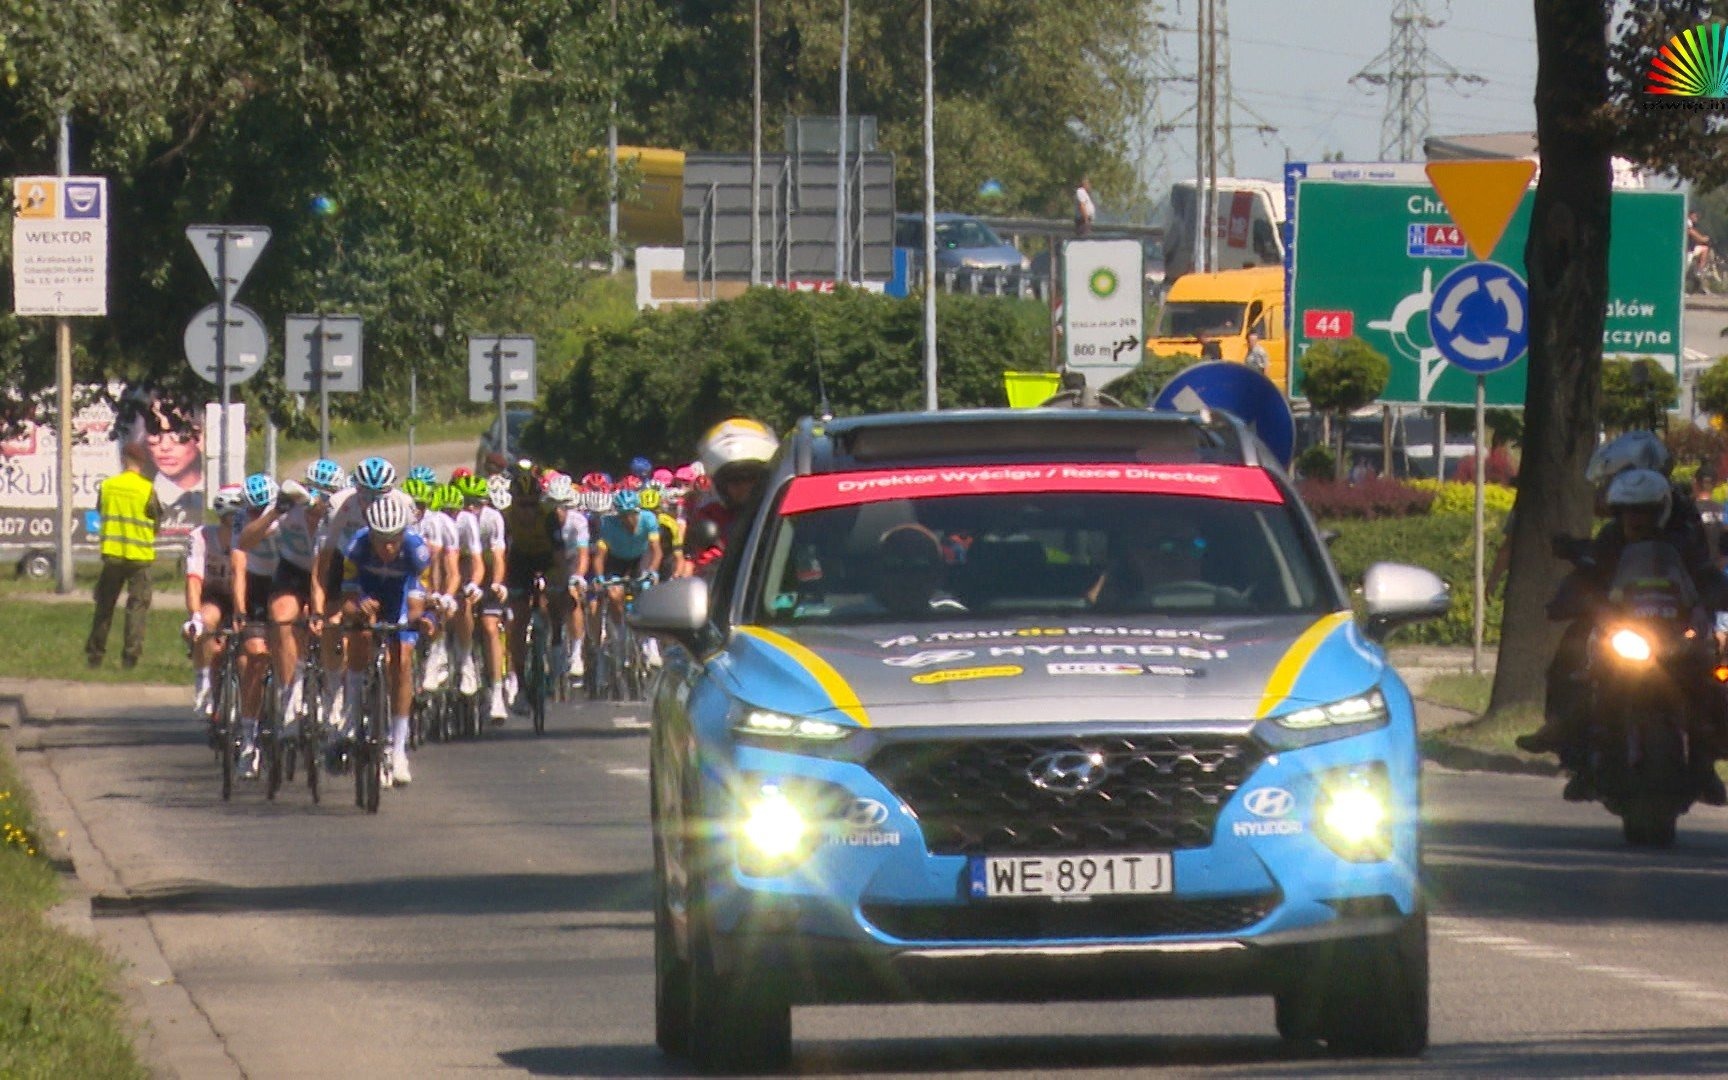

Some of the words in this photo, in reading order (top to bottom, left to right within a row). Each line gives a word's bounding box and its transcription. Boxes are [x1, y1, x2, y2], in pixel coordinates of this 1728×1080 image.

[1407, 194, 1449, 214] Chr
[26, 231, 92, 244] WEKTOR
[1434, 229, 1460, 244] A4
[1606, 298, 1655, 317] aków
[1315, 316, 1341, 333] 44
[1603, 331, 1671, 347] zczyna
[838, 474, 937, 491] Dyrektor
[1062, 467, 1121, 479] Race
[1125, 468, 1220, 484] Director
[989, 644, 1229, 660] HYUNDAI
[1233, 820, 1303, 837] HYUNDAI
[992, 861, 1043, 893] WE
[1057, 857, 1162, 893] 891TJ
